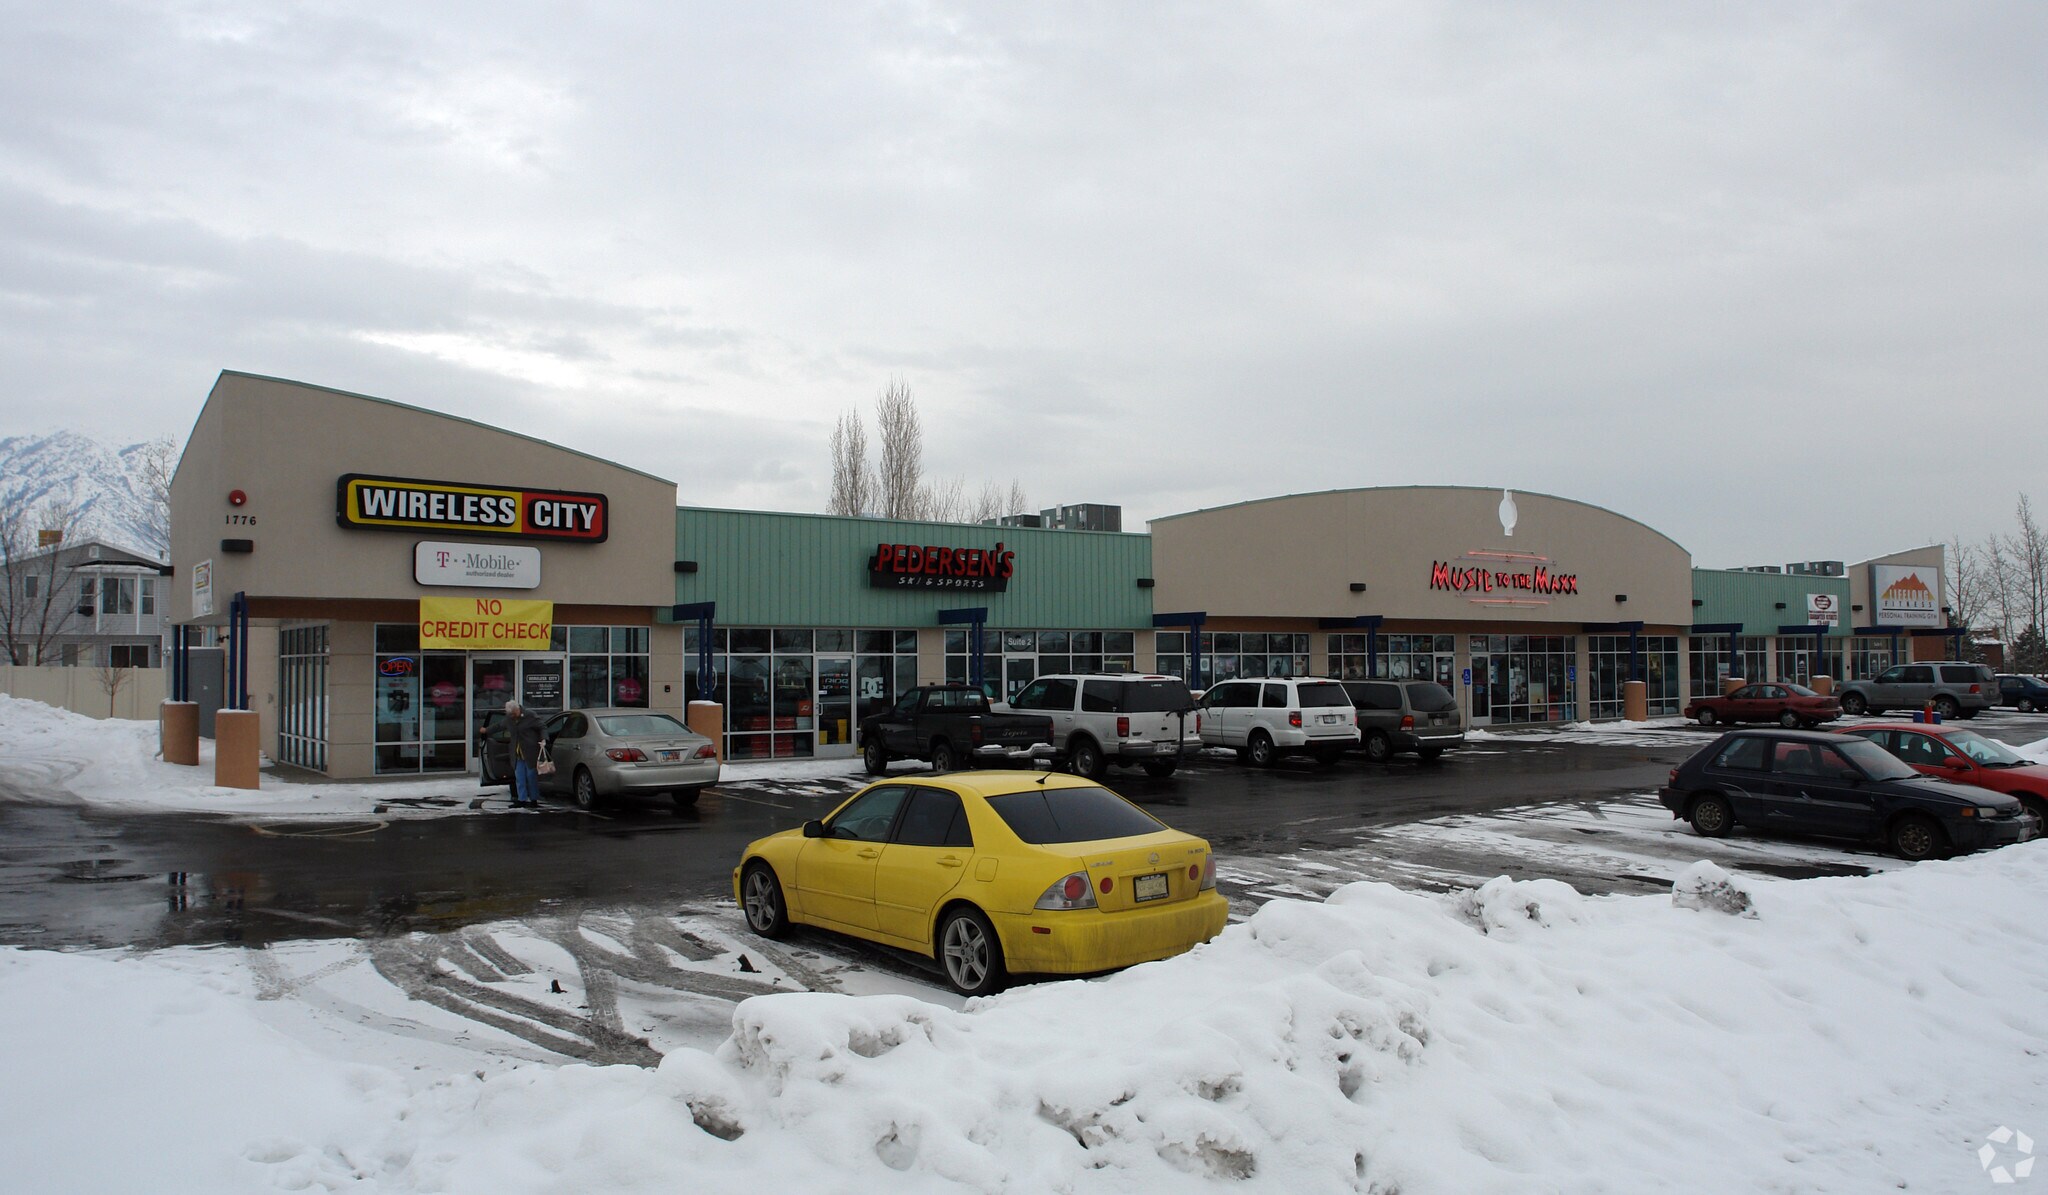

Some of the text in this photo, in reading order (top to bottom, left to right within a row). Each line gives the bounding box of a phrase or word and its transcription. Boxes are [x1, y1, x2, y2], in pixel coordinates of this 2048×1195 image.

[363, 488, 597, 530] WIRELESS CITY
[226, 515, 256, 525] 1776
[877, 542, 1015, 578] PEDERSEN'S
[898, 577, 985, 588] SKI & SPORTS
[1496, 572, 1510, 588] TO
[1512, 573, 1531, 589] THE
[1889, 589, 1929, 600] LIFELONG
[476, 599, 502, 616] NO
[1904, 612, 1926, 620] TRAINING
[422, 621, 550, 640] CREDIT CHECK
[1008, 637, 1032, 646] Suite 2
[379, 660, 413, 673] OPEN
